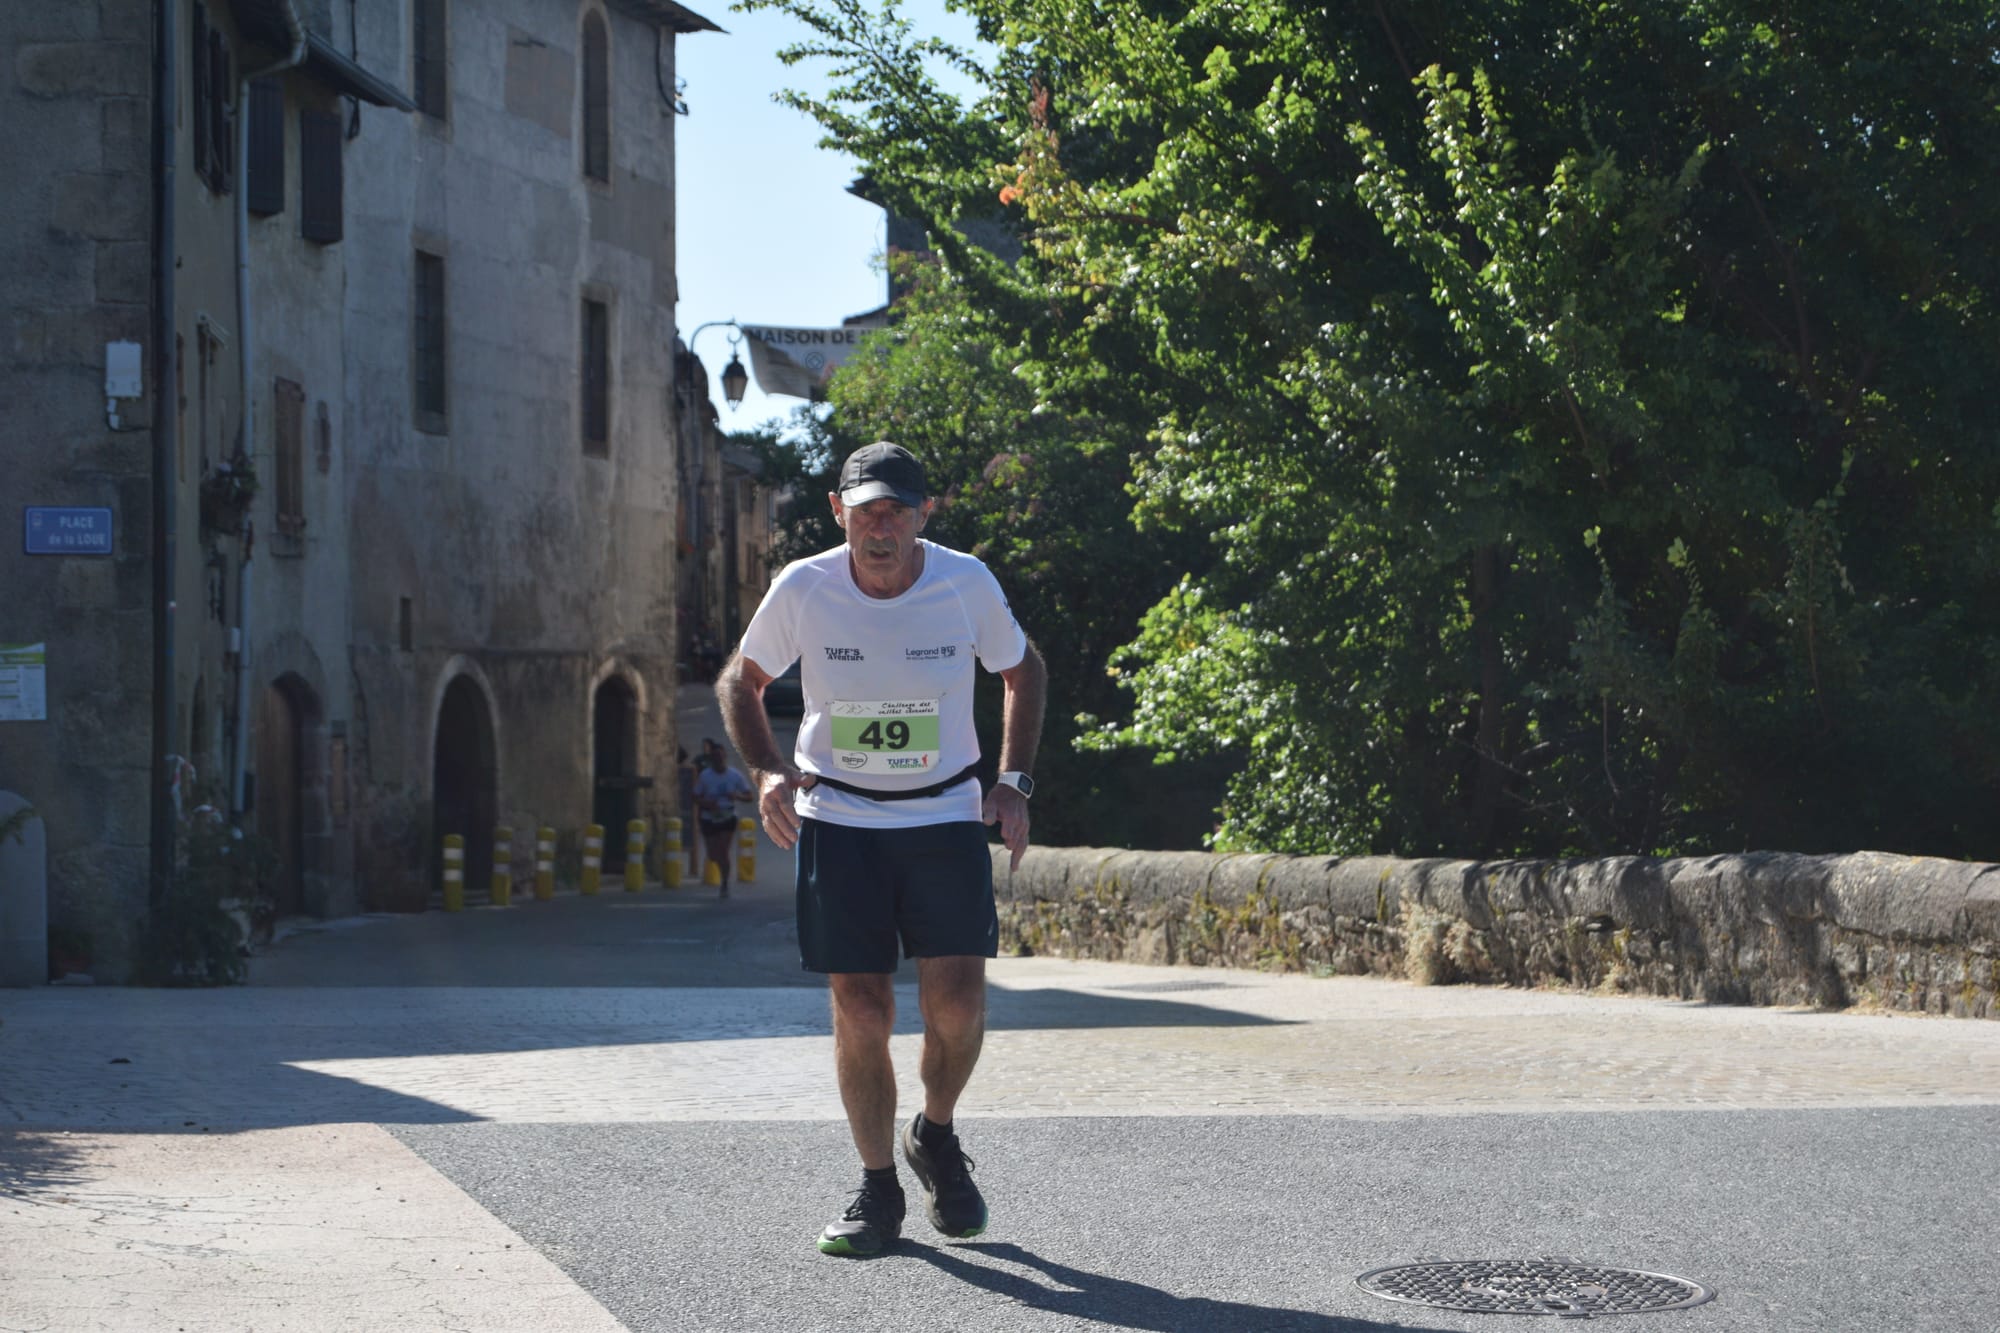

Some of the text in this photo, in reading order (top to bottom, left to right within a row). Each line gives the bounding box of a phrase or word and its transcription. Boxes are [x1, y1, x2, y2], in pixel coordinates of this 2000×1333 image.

[749, 329, 825, 344] MAISON
[832, 330, 855, 344] DE
[59, 515, 94, 528] PLACE
[48, 533, 61, 545] de
[824, 646, 861, 656] TUFF'S
[905, 647, 939, 657] Legrand
[858, 720, 910, 750] 49
[887, 757, 919, 765] TUFF'S
